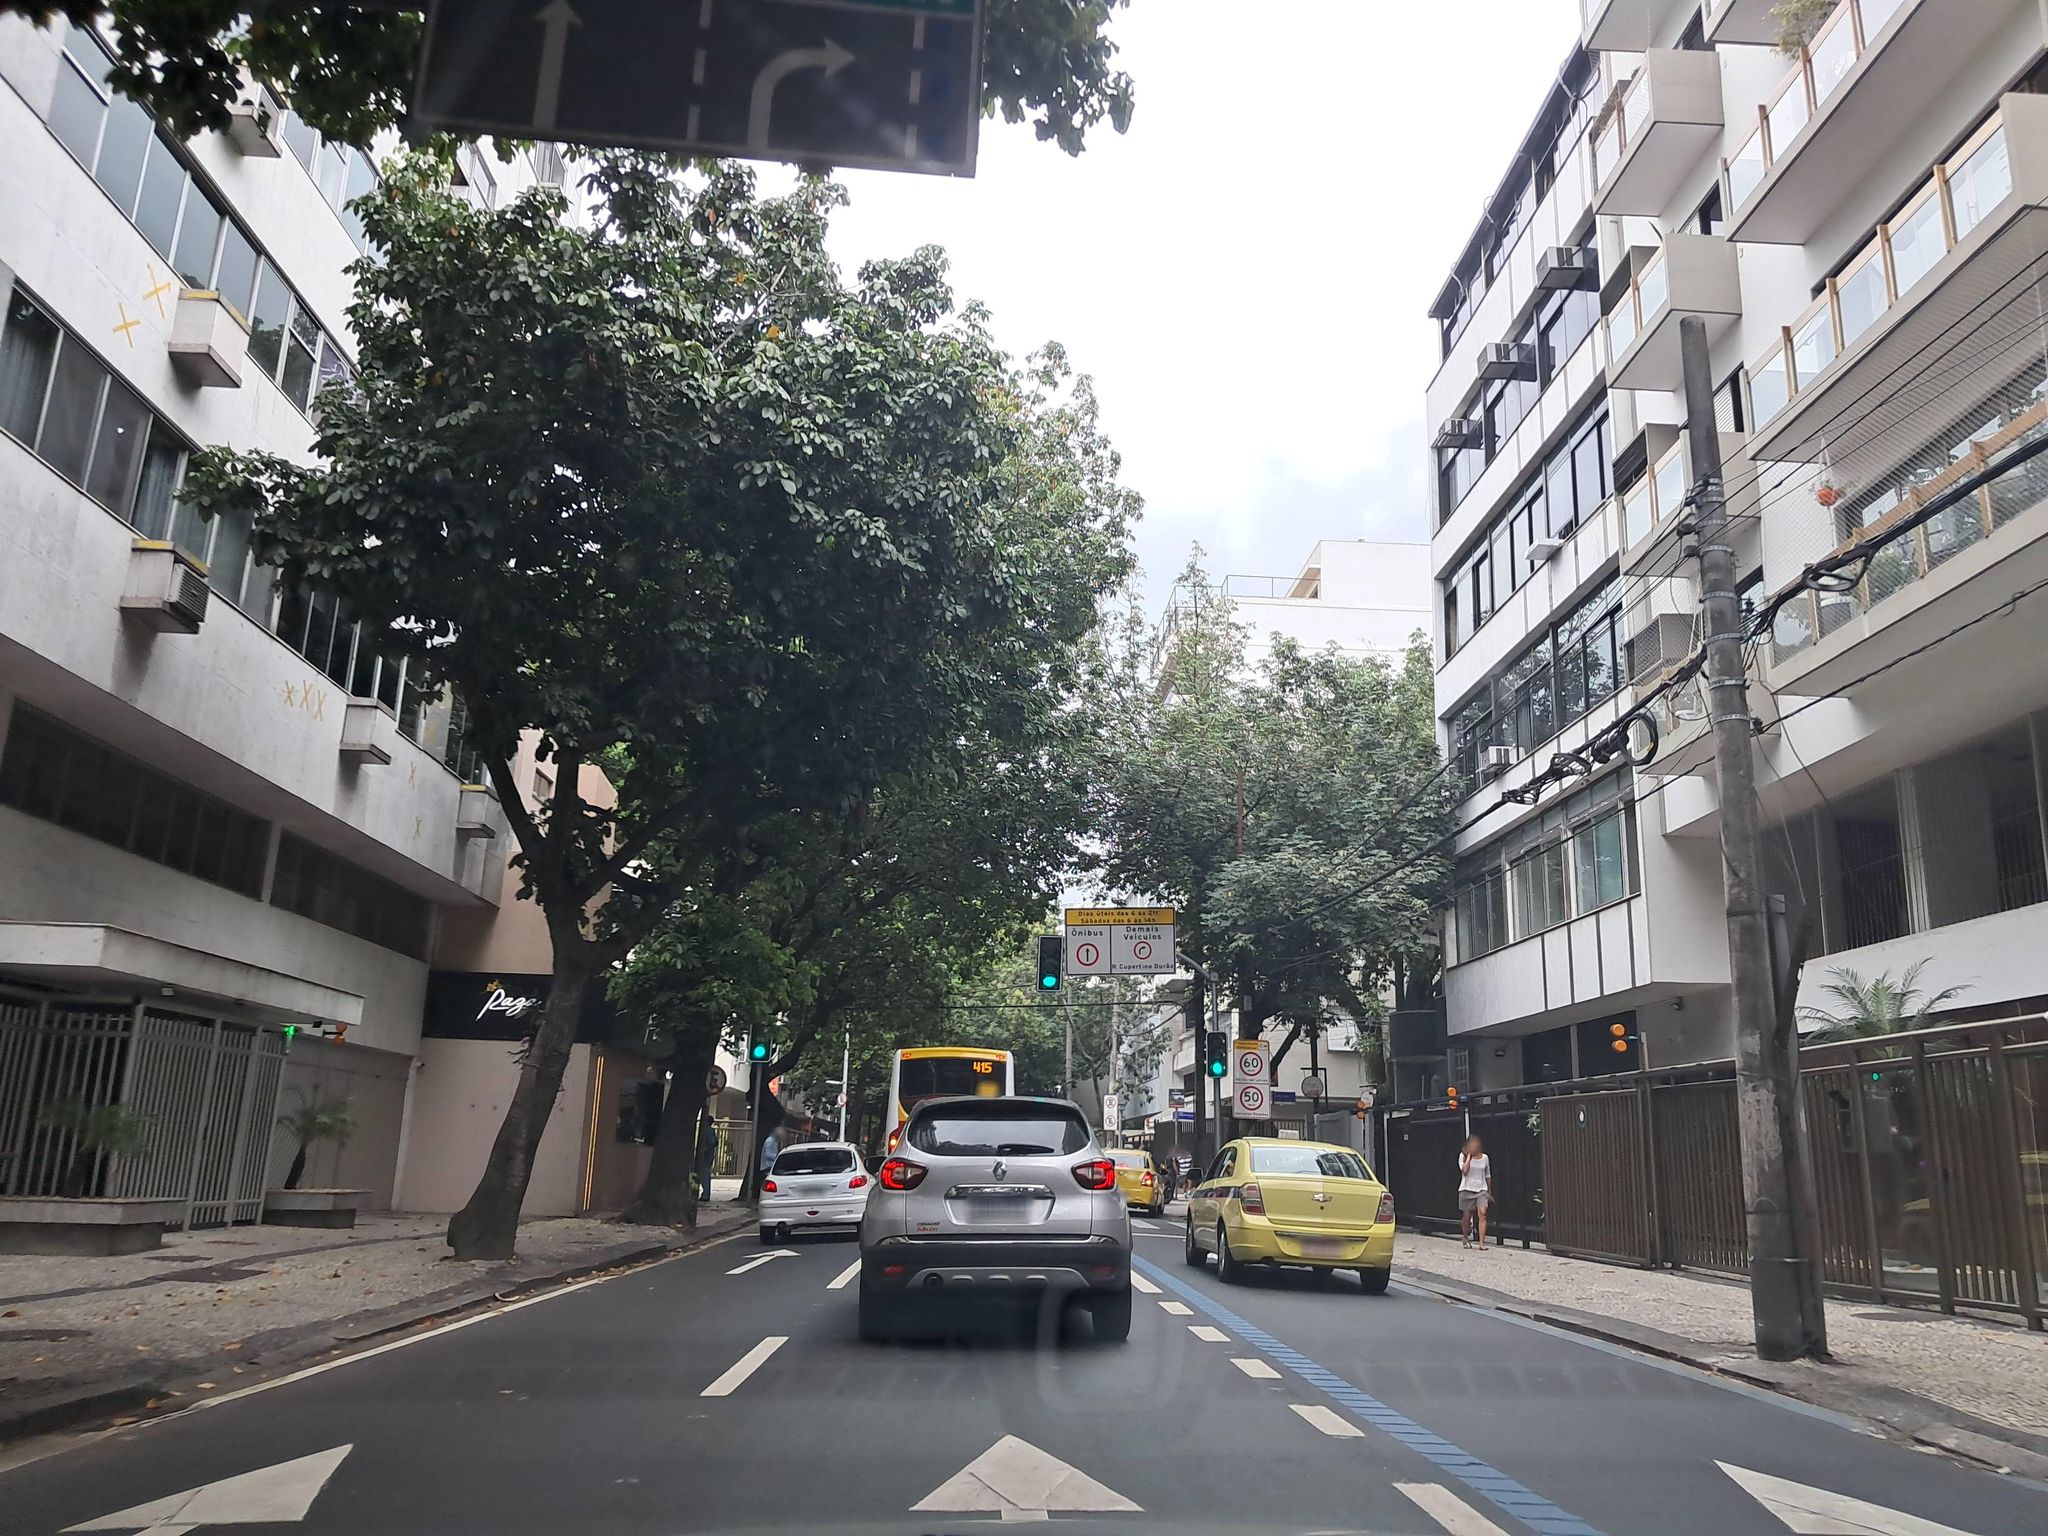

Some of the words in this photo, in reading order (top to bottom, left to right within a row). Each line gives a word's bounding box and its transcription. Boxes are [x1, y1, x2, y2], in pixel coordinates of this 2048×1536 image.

[1071, 928, 1104, 937] Ônibus
[973, 1061, 993, 1073] 415
[1244, 1057, 1259, 1068] 60
[1244, 1091, 1260, 1102] 50
